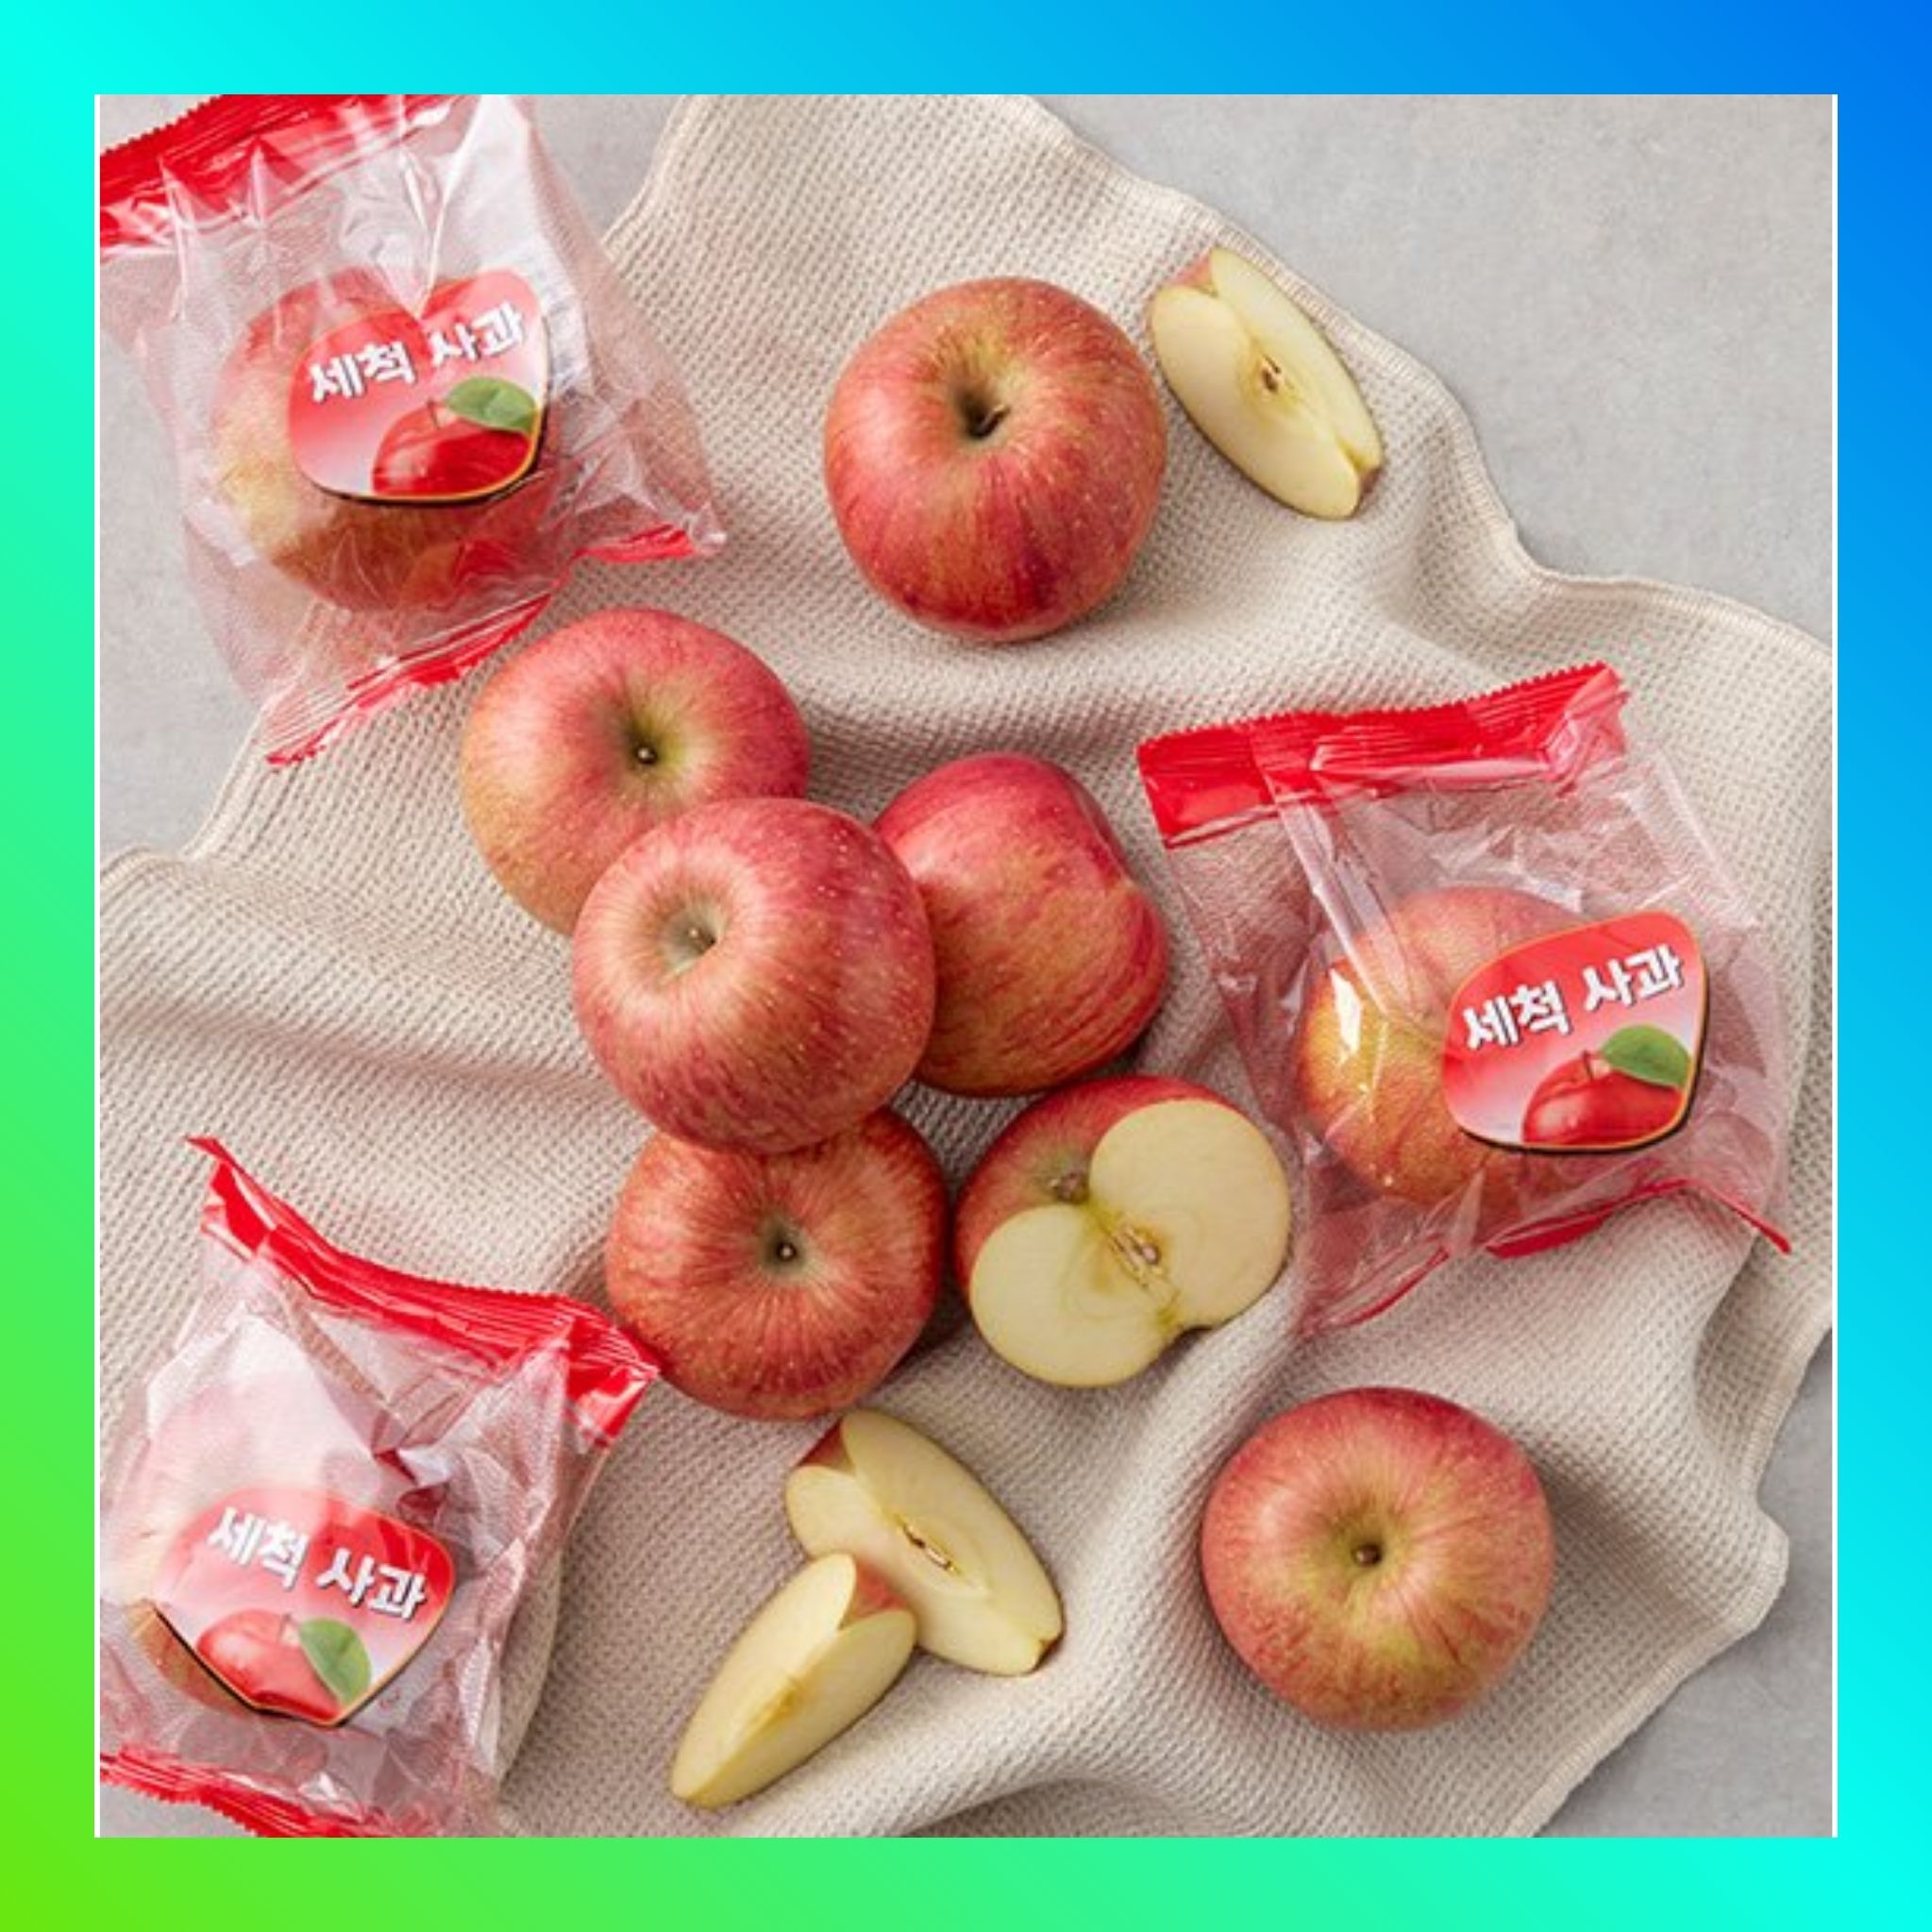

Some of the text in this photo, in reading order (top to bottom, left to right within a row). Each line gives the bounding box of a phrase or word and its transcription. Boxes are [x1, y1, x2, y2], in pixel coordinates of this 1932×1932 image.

[310, 301, 523, 403] 세척 사과
[1463, 944, 1684, 1050] 세척 사과
[207, 1506, 428, 1621] 세척 사과
